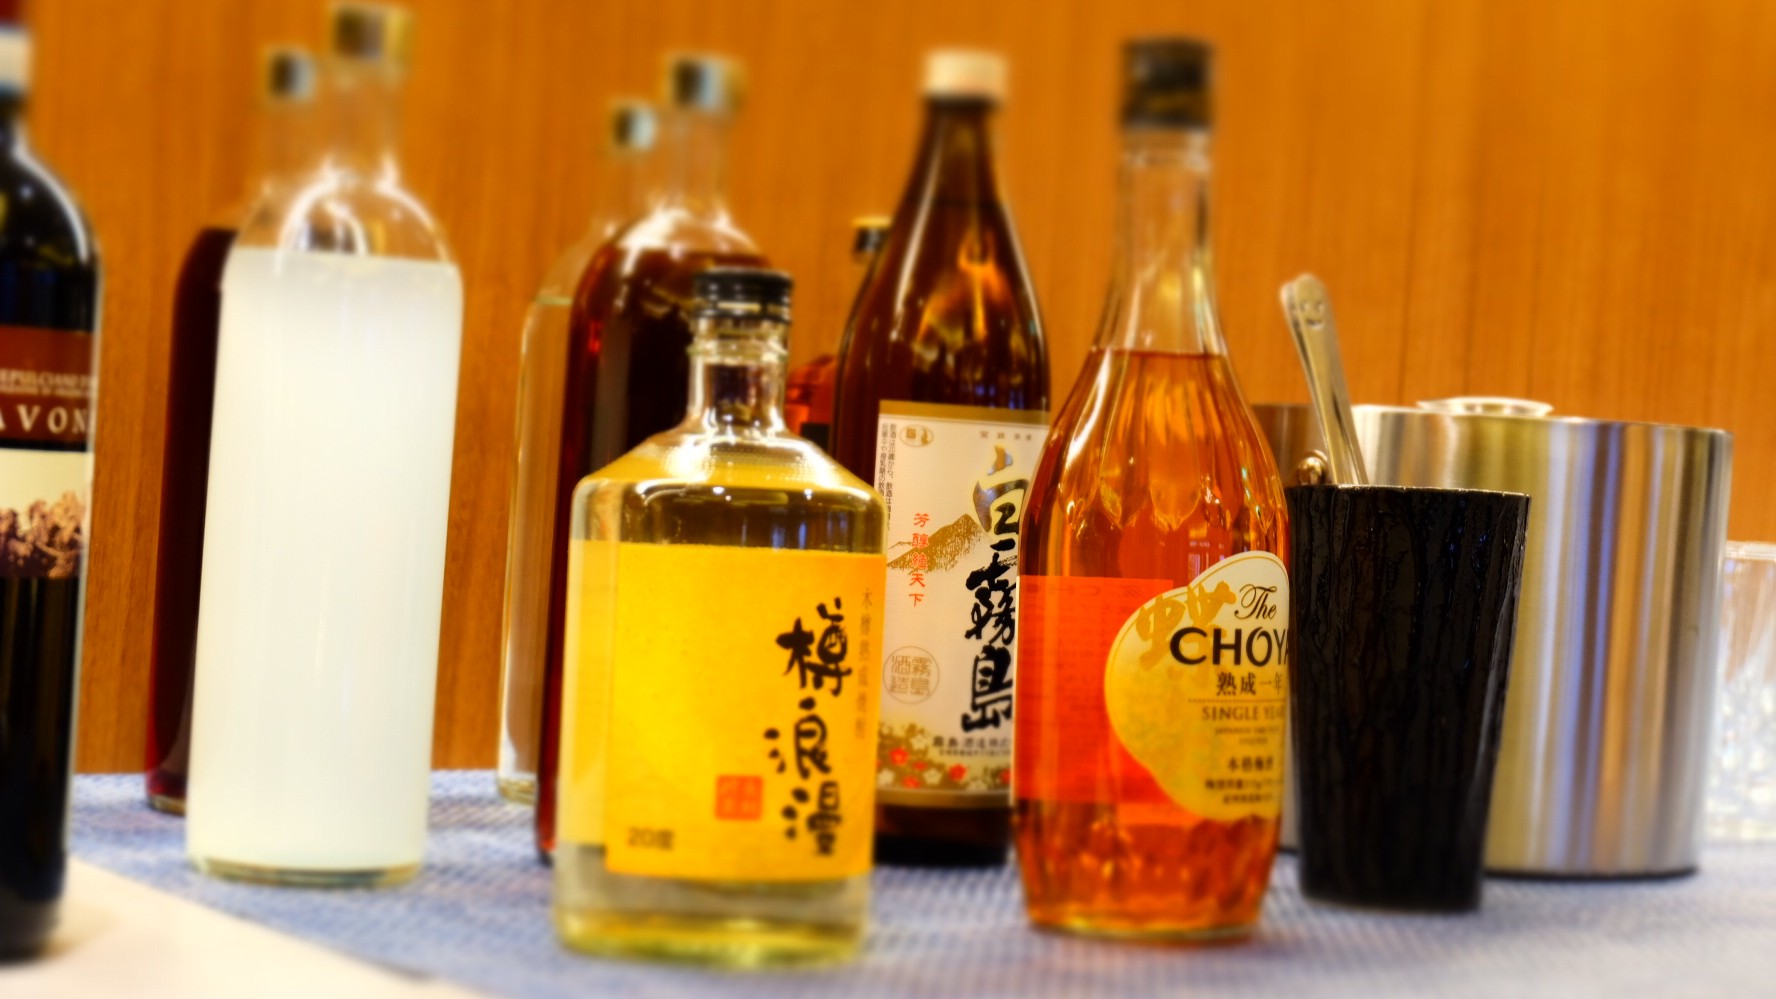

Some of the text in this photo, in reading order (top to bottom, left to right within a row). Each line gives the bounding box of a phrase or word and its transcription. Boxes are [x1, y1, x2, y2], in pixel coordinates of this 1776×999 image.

[0, 404, 88, 433] VON
[1234, 583, 1278, 620] The
[1216, 671, 1283, 697] 熟成一年
[1202, 705, 1259, 721] SINGLE
[628, 828, 674, 850] 20度
